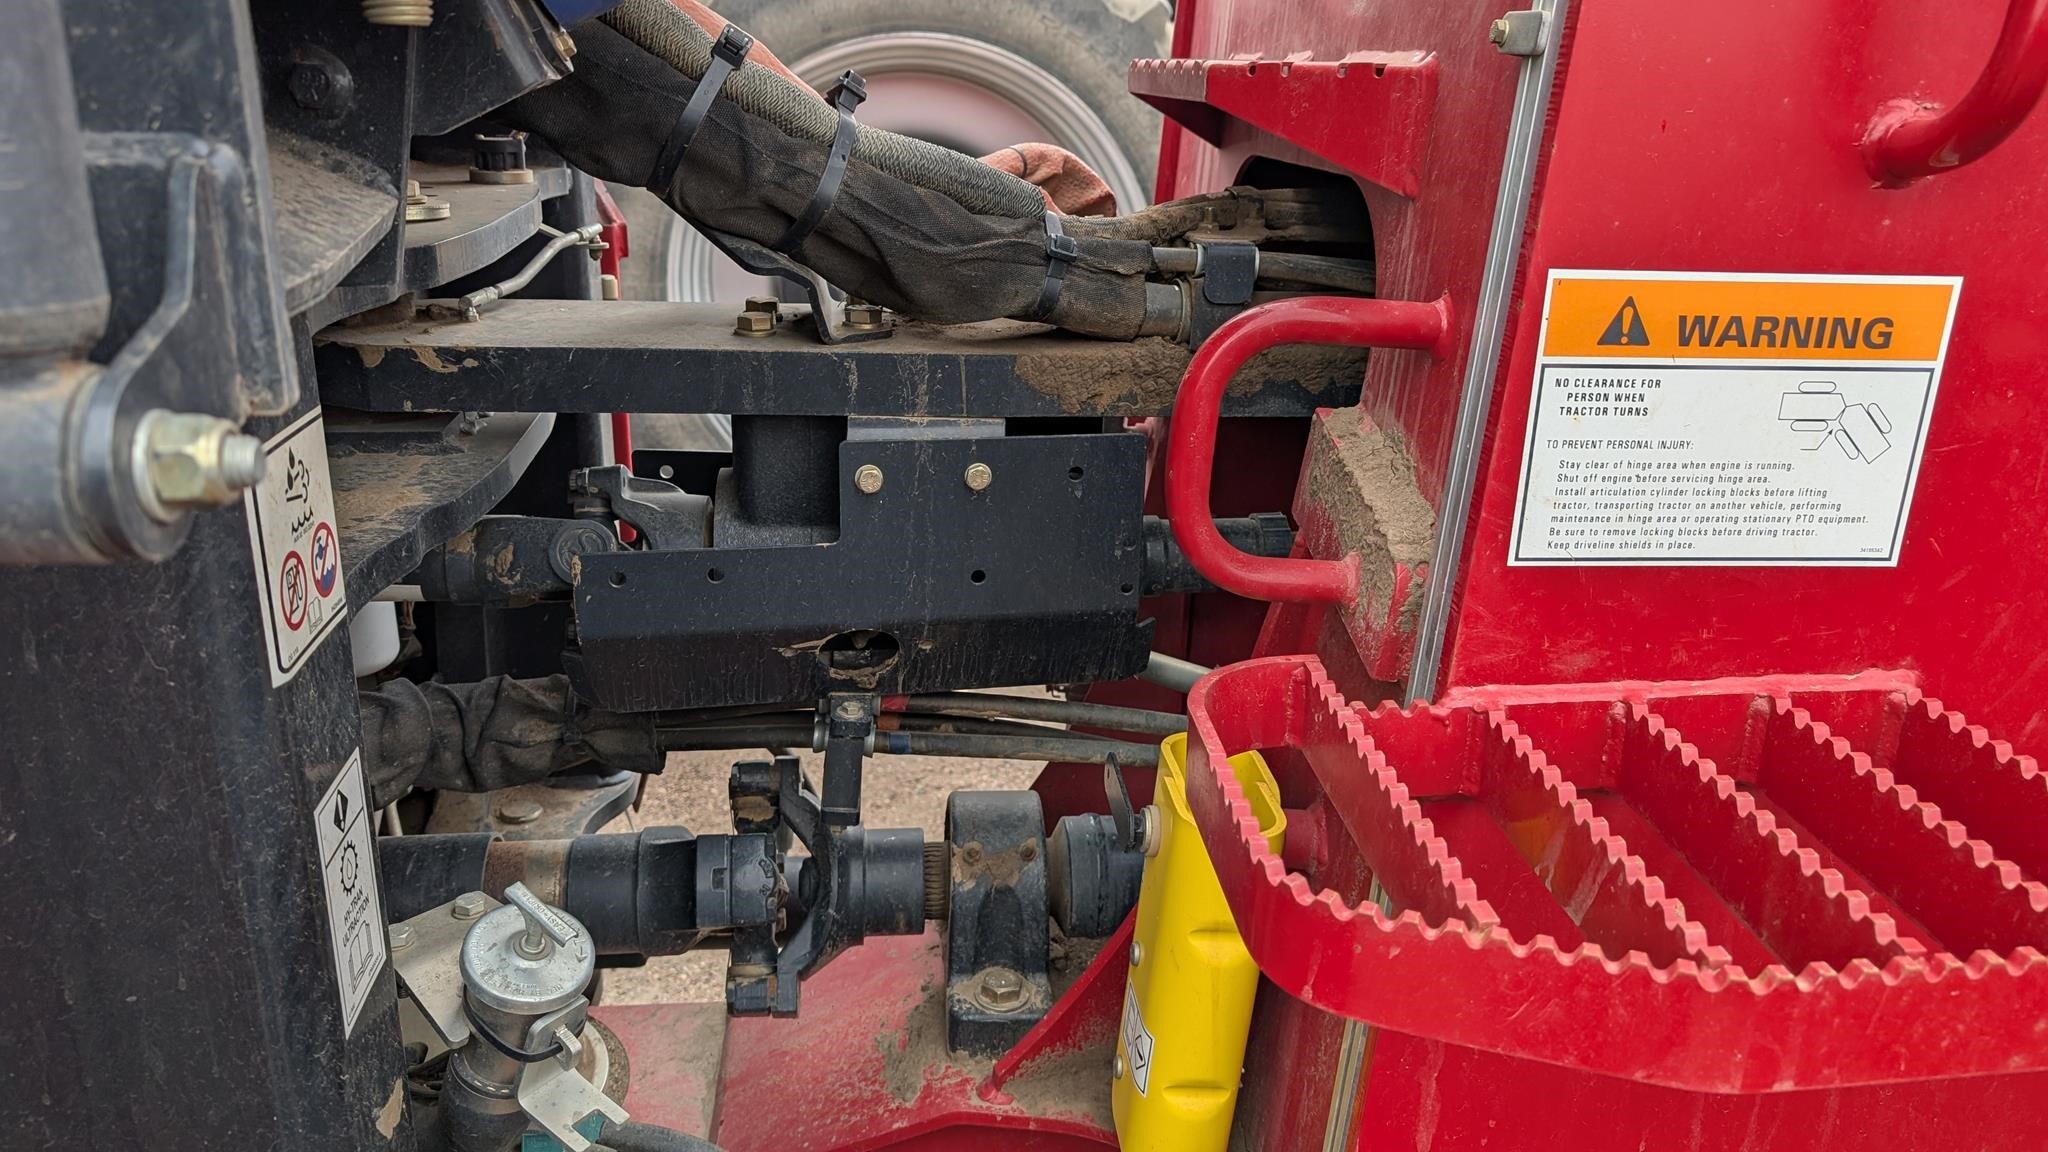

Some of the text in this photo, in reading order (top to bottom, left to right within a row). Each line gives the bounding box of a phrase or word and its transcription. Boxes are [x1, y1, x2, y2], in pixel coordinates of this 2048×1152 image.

[1678, 315, 1894, 349] WARNING
[1555, 378, 1661, 388] NO CLEARANCE FOR
[1567, 393, 1645, 402] PERSON WHEN
[1559, 407, 1648, 416] TRACTOR TURNS
[1547, 440, 1694, 449] TO PREVENT PERSONAL INJURY:
[1559, 460, 1581, 470] Stay
[1586, 460, 1609, 469] clear
[1613, 460, 1623, 469] of
[1627, 460, 1652, 471] hinge
[1681, 461, 1706, 469] when
[1710, 461, 1741, 471] engine
[1744, 461, 1752, 469] is
[1757, 461, 1795, 472] running.
[1557, 474, 1579, 482] Shut
[1583, 474, 1597, 482] off
[1601, 474, 1632, 484] engine
[1636, 474, 1667, 483] before
[1671, 475, 1714, 485] servicing
[1718, 474, 1743, 485] hinge
[1555, 487, 1827, 498] Install articulation cylinder locking blocks before lifting
[1553, 502, 1590, 510] tractor,
[1595, 502, 1654, 511] transporting
[1658, 502, 1691, 510] tractor
[1710, 502, 1746, 510] another
[1750, 501, 1786, 511] vehicle,
[1790, 502, 1841, 512] performing
[1551, 515, 1611, 523] maintenance
[1615, 515, 1623, 523] in
[1627, 515, 1652, 524] hinge
[1694, 515, 1739, 524] operating
[1743, 514, 1791, 525] stationary
[1795, 514, 1814, 523] PTO
[1818, 515, 1868, 525] equipment.
[1549, 528, 1561, 536] Be
[1640, 528, 1674, 537] locking
[1678, 528, 1708, 536] blocks
[1712, 528, 1742, 536] before
[1746, 528, 1778, 537] driving
[1547, 541, 1695, 551] Keep driveline shields in place.
[343, 885, 364, 923] HY-TRAN
[342, 895, 370, 948] ULTRACTION
